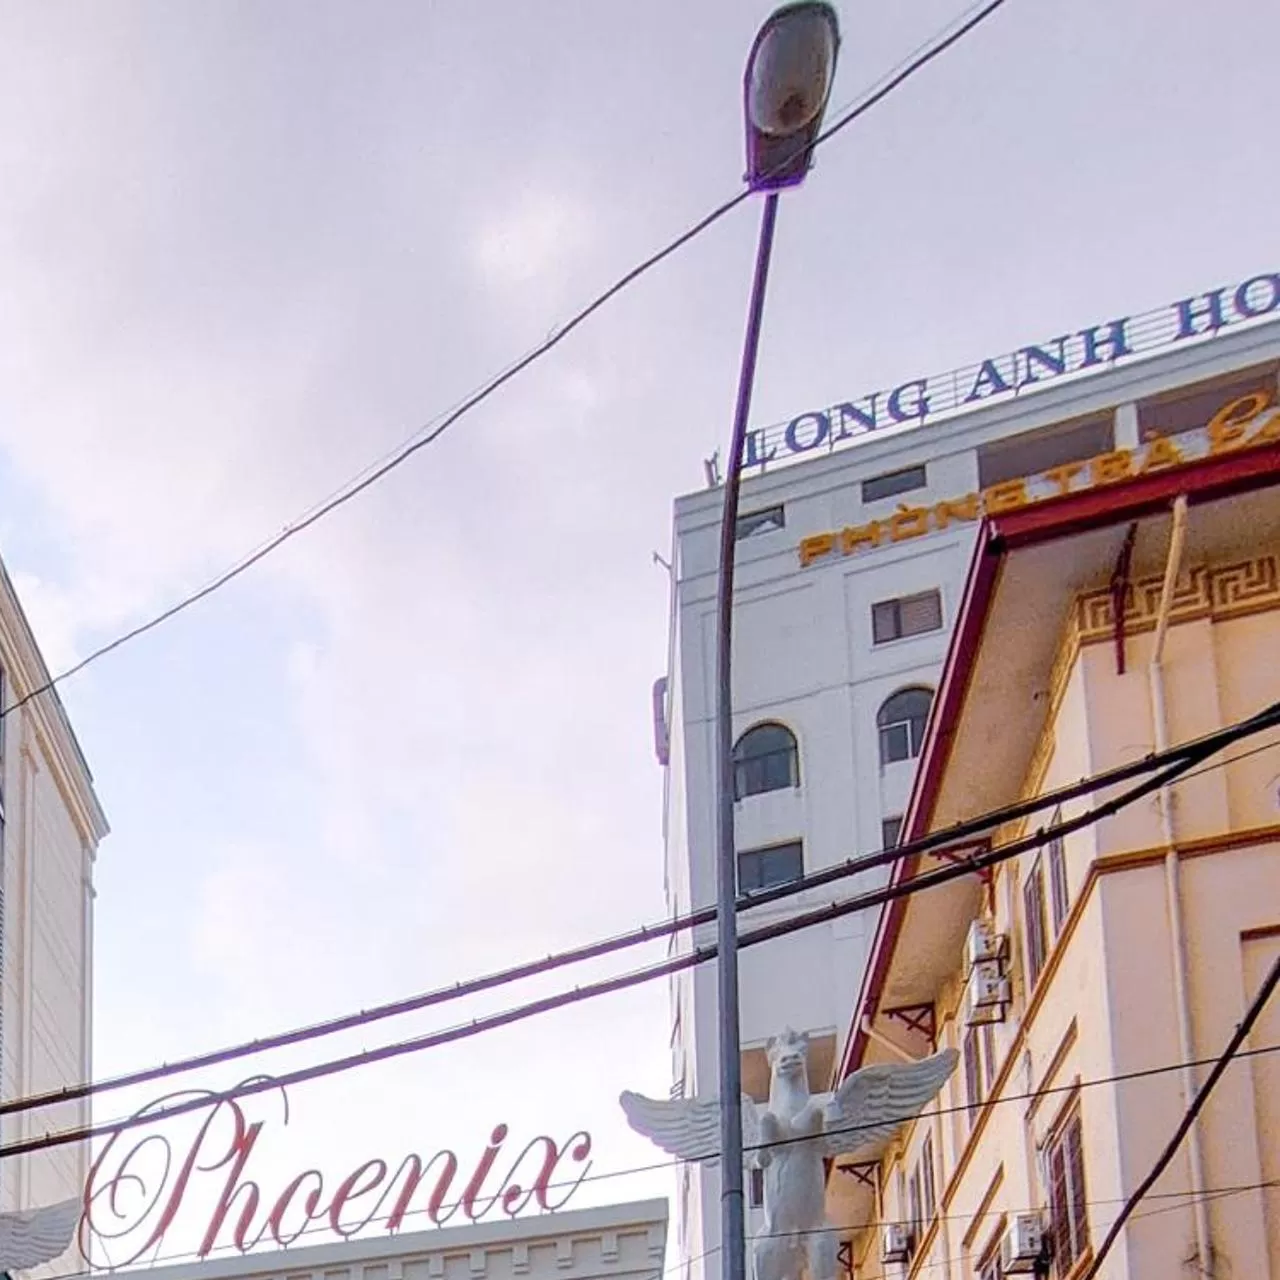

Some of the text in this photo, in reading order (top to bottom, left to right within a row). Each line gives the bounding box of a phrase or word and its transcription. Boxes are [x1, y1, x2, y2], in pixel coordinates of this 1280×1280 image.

[740, 272, 1280, 468] LONG ANH HO
[798, 427, 1184, 568] PHÒNG TRÀ
[78, 1074, 593, 1269] Phoenix
